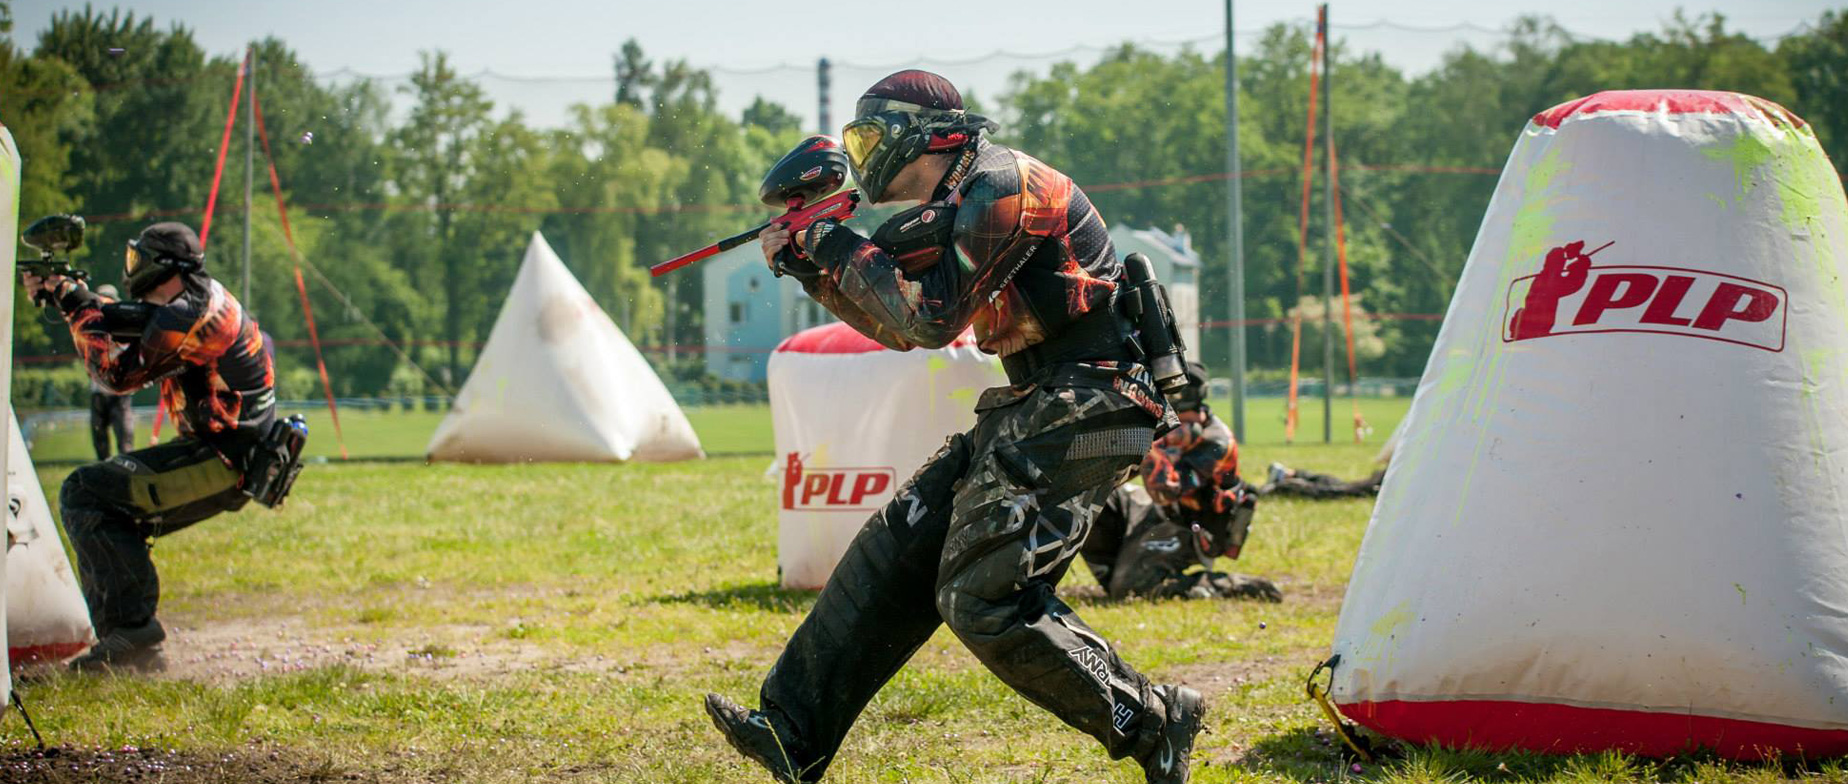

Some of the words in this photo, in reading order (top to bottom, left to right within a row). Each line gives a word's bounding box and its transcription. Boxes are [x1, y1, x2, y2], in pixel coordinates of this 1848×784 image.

[999, 245, 1037, 288] SEETHALER
[1572, 273, 1779, 331] PLP
[801, 473, 890, 505] PLP
